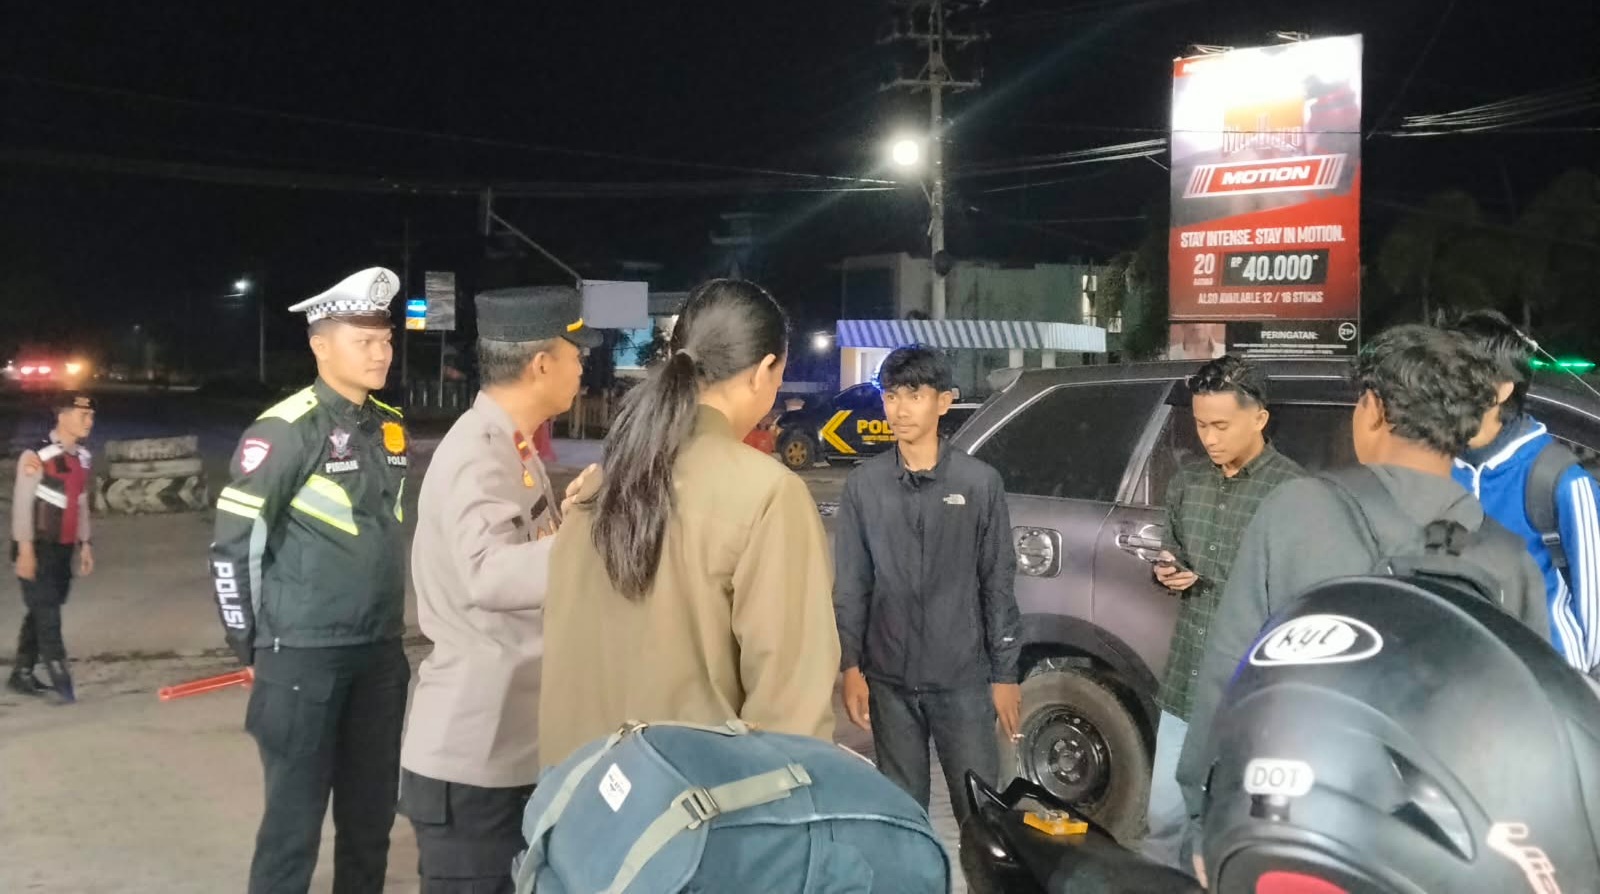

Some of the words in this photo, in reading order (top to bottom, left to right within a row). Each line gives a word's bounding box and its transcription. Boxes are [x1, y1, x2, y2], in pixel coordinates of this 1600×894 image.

[1221, 165, 1311, 186] MOTION
[1180, 231, 1207, 248] STAY
[1207, 229, 1254, 247] INTENSE.
[1255, 227, 1283, 245] STAY
[1283, 226, 1296, 244] IN
[1297, 224, 1346, 243] MOTION.
[1193, 253, 1216, 275] 20
[1198, 293, 1219, 305] ALSO
[1219, 292, 1262, 304] AVAILABLE
[1262, 292, 1273, 303] 12
[1273, 292, 1281, 303] /
[1292, 291, 1324, 303] STICKS
[213, 561, 246, 629] POLISI
[1251, 765, 1302, 789] DOT
